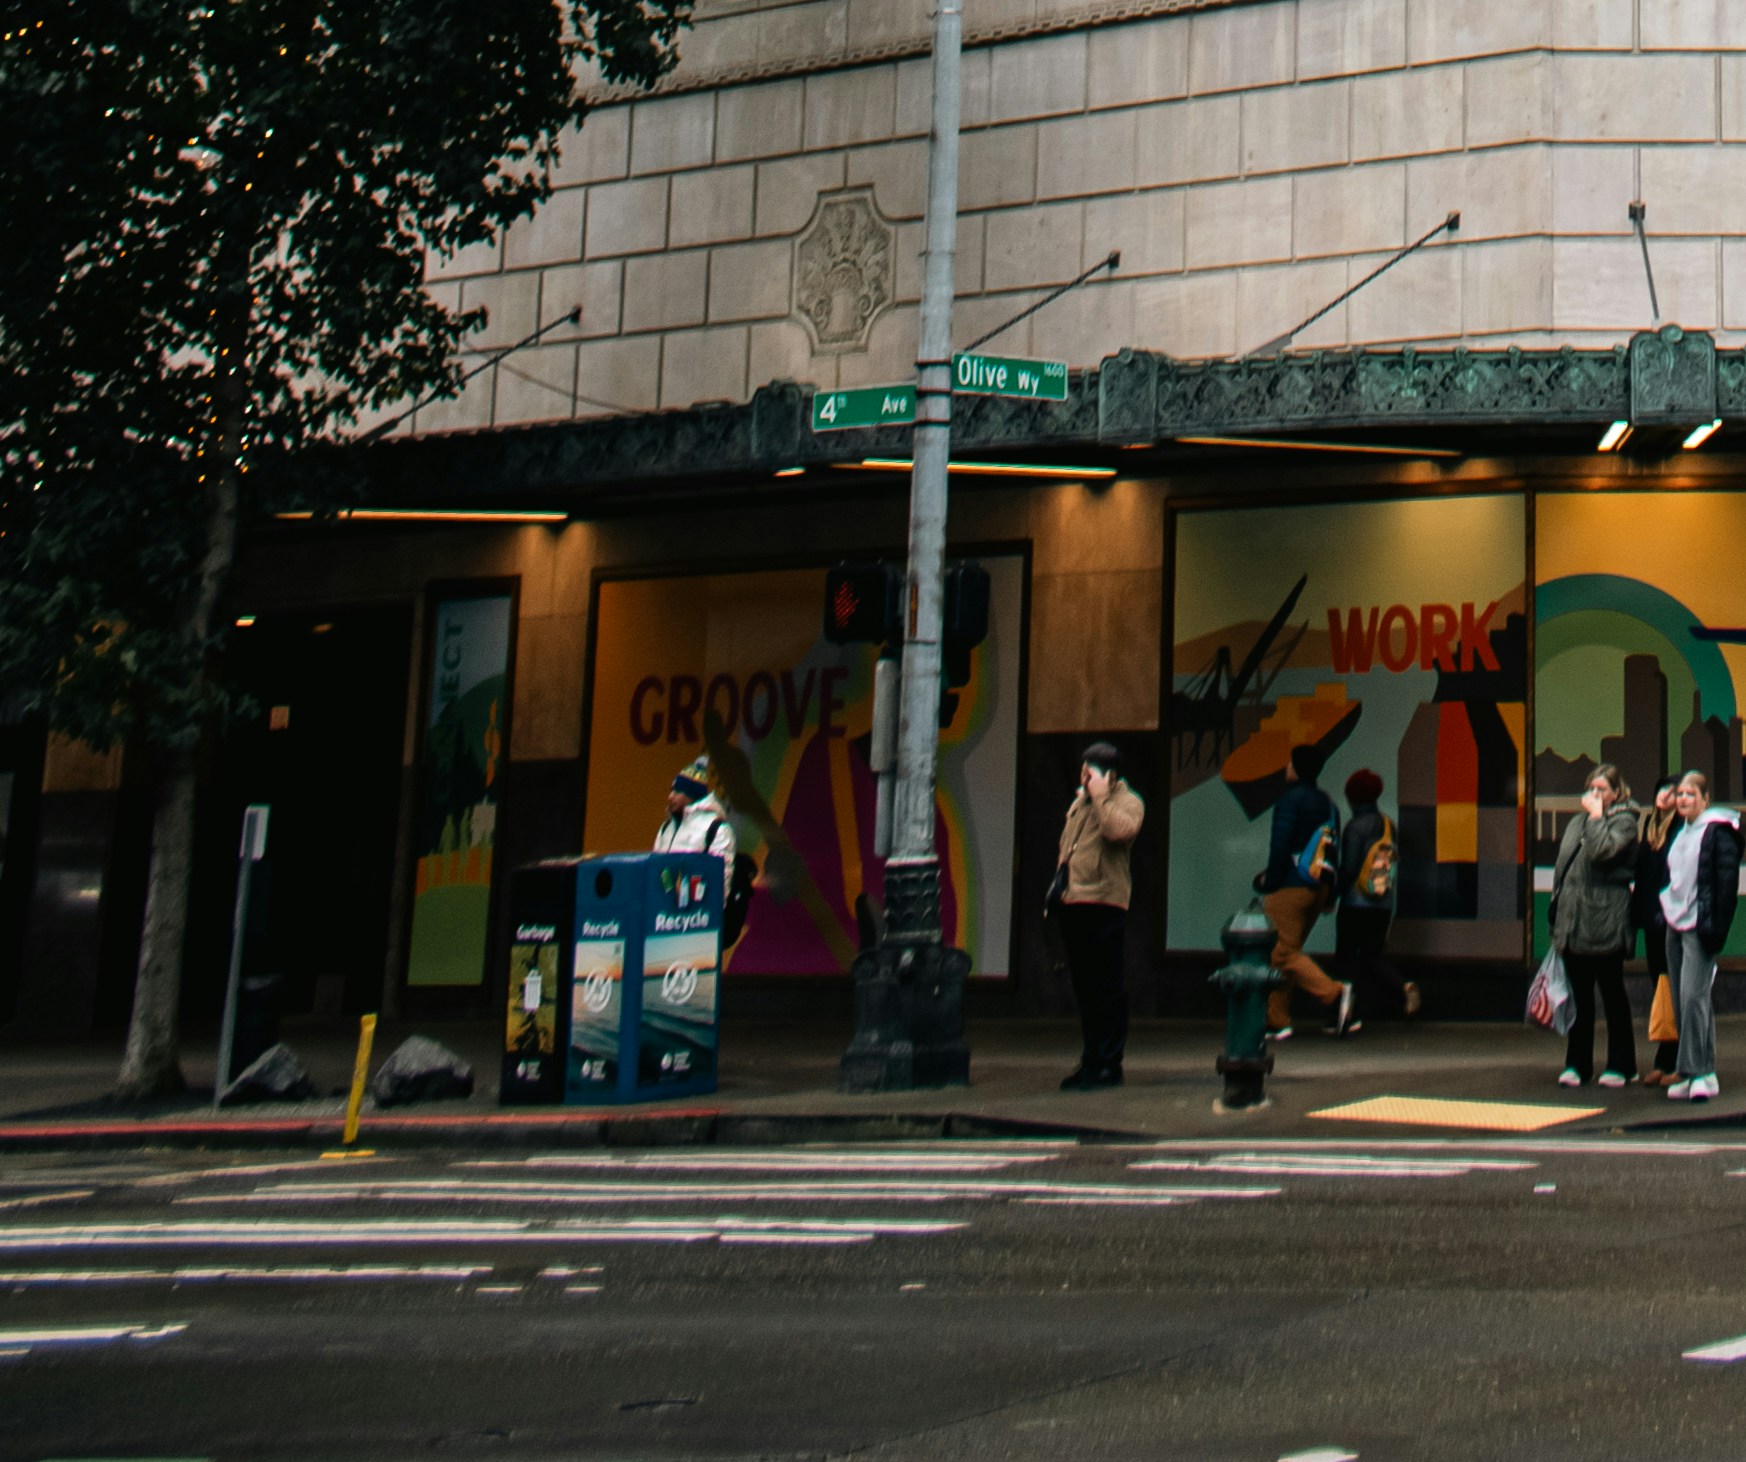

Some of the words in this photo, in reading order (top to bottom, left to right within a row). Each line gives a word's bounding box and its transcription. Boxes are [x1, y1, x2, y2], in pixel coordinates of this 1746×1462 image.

[958, 355, 1007, 389] Olive
[1018, 370, 1039, 396] Wy
[881, 394, 907, 415] Ave
[1327, 601, 1501, 674] WORK
[630, 666, 850, 746] GROOVE
[516, 923, 556, 944] Garbage
[582, 919, 620, 939] Recycle
[655, 912, 710, 934] Recycle
